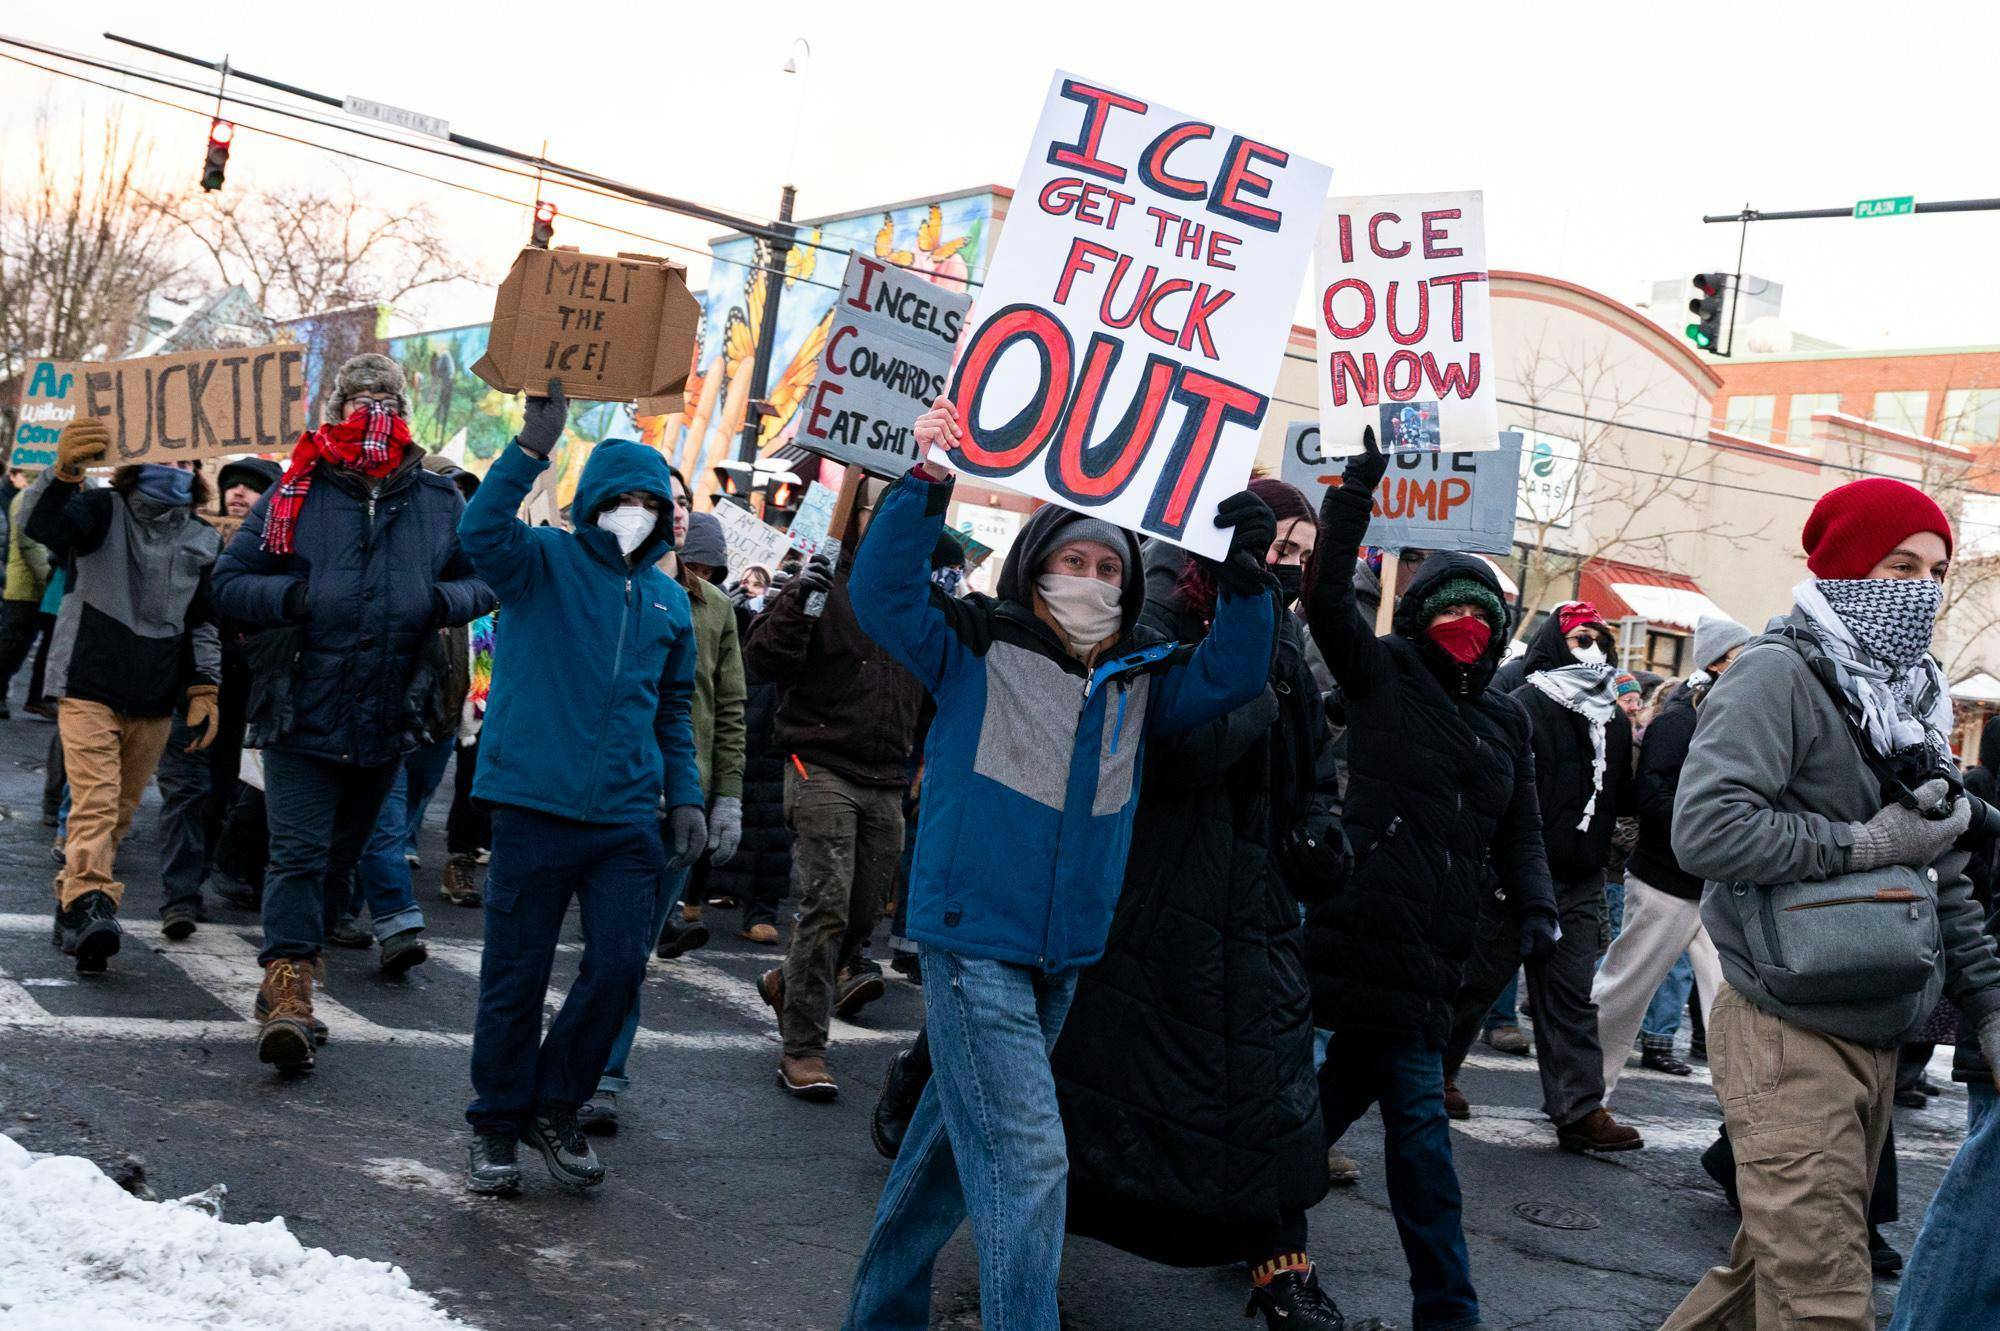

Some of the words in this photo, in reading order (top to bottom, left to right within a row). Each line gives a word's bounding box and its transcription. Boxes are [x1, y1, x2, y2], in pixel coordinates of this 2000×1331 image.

[1046, 78, 1289, 233] ICE
[1038, 176, 1135, 230] GET
[1146, 206, 1243, 271] THE
[1338, 209, 1464, 263] ICE
[1858, 201, 1896, 216] PLAIN
[545, 256, 640, 303] MELT
[847, 256, 961, 344] INCELS
[1053, 237, 1236, 361] FUCK
[1323, 272, 1489, 345] OUT
[558, 305, 606, 331] THE
[544, 341, 611, 381] ICE!
[826, 325, 945, 408] COWARDS
[1330, 350, 1481, 407] NOW
[807, 379, 868, 445] EAT
[946, 302, 1270, 542] OUT
[1317, 475, 1471, 521] UMP
